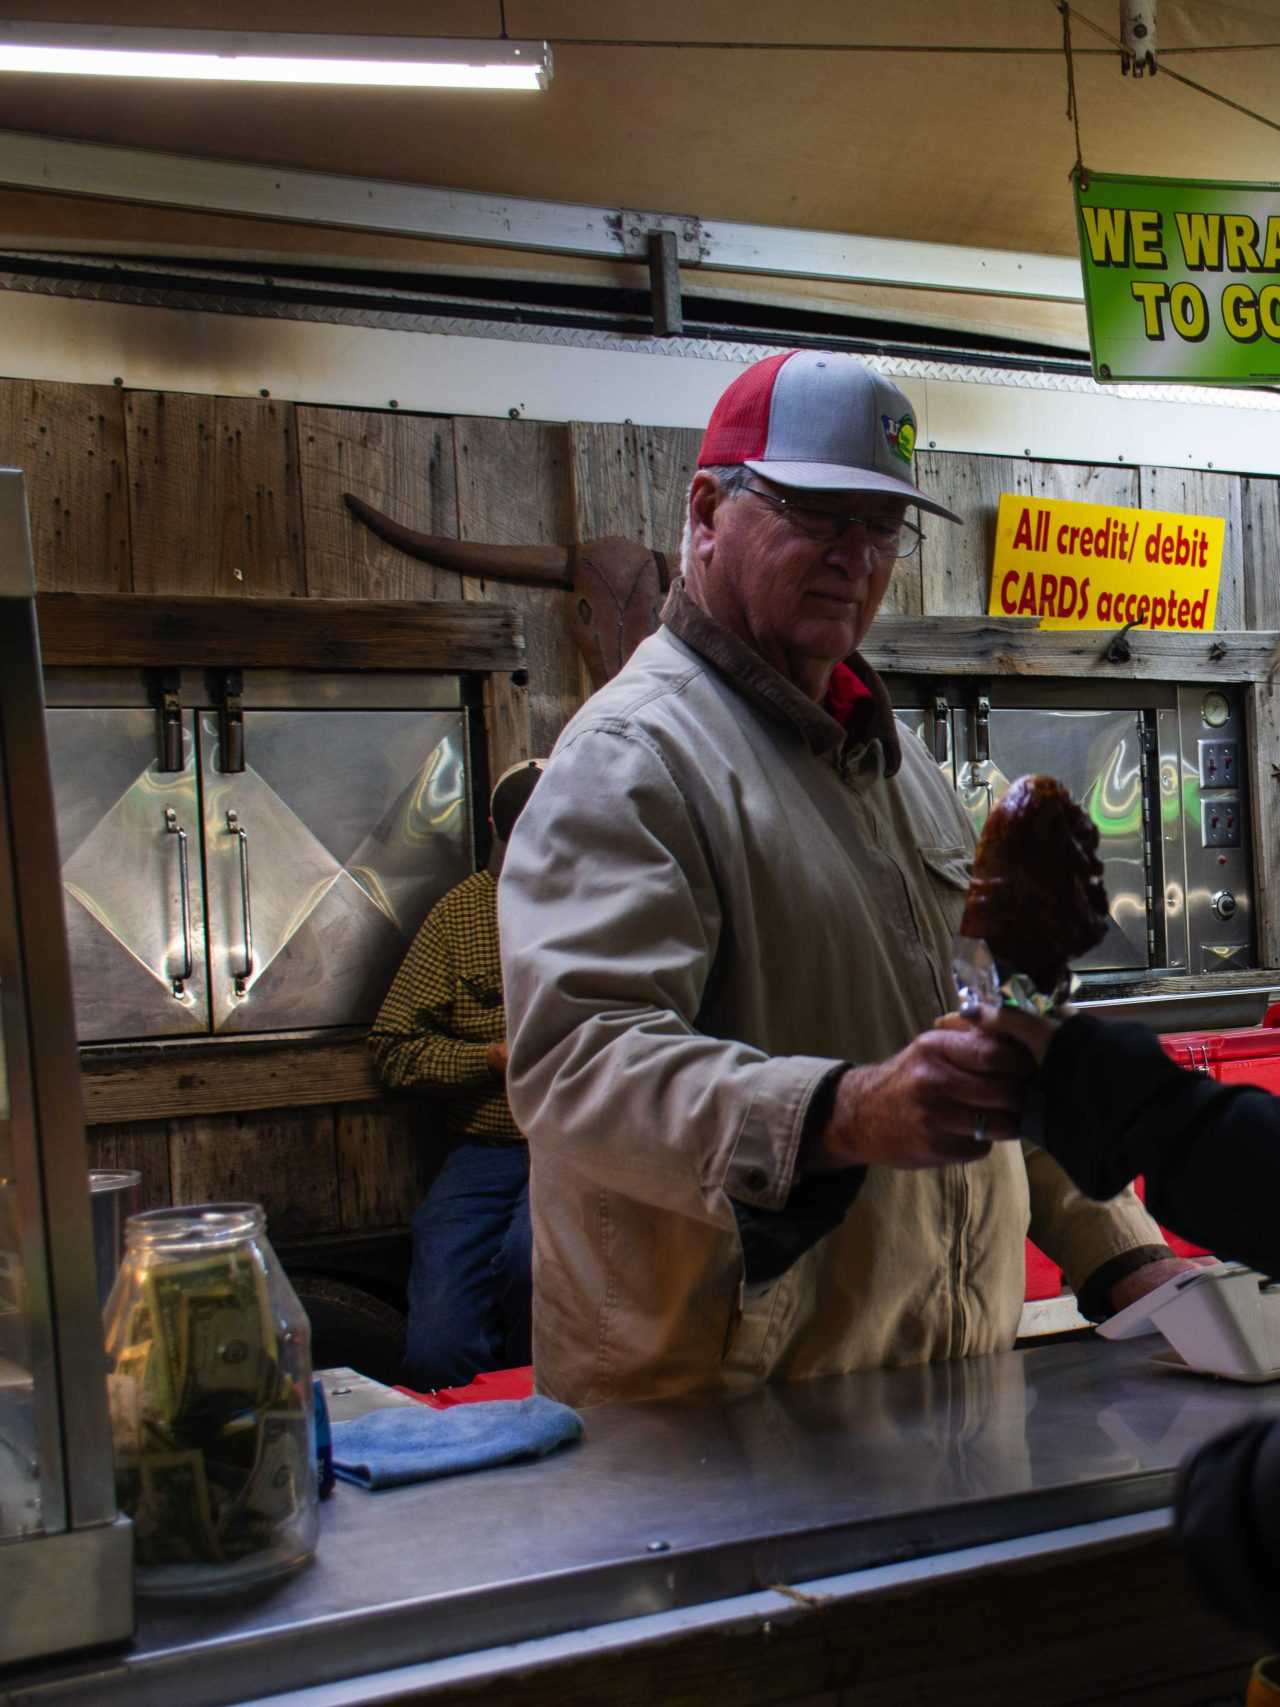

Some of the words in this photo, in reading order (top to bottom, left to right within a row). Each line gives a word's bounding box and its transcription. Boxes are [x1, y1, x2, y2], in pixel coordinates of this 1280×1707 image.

[1081, 206, 1167, 270] WE
[1131, 281, 1209, 342] TO
[1012, 508, 1050, 552] All
[1057, 517, 1139, 564] credit/
[1145, 523, 1209, 568] debit
[1001, 570, 1090, 620] CARDS
[1096, 589, 1210, 630] accepted
